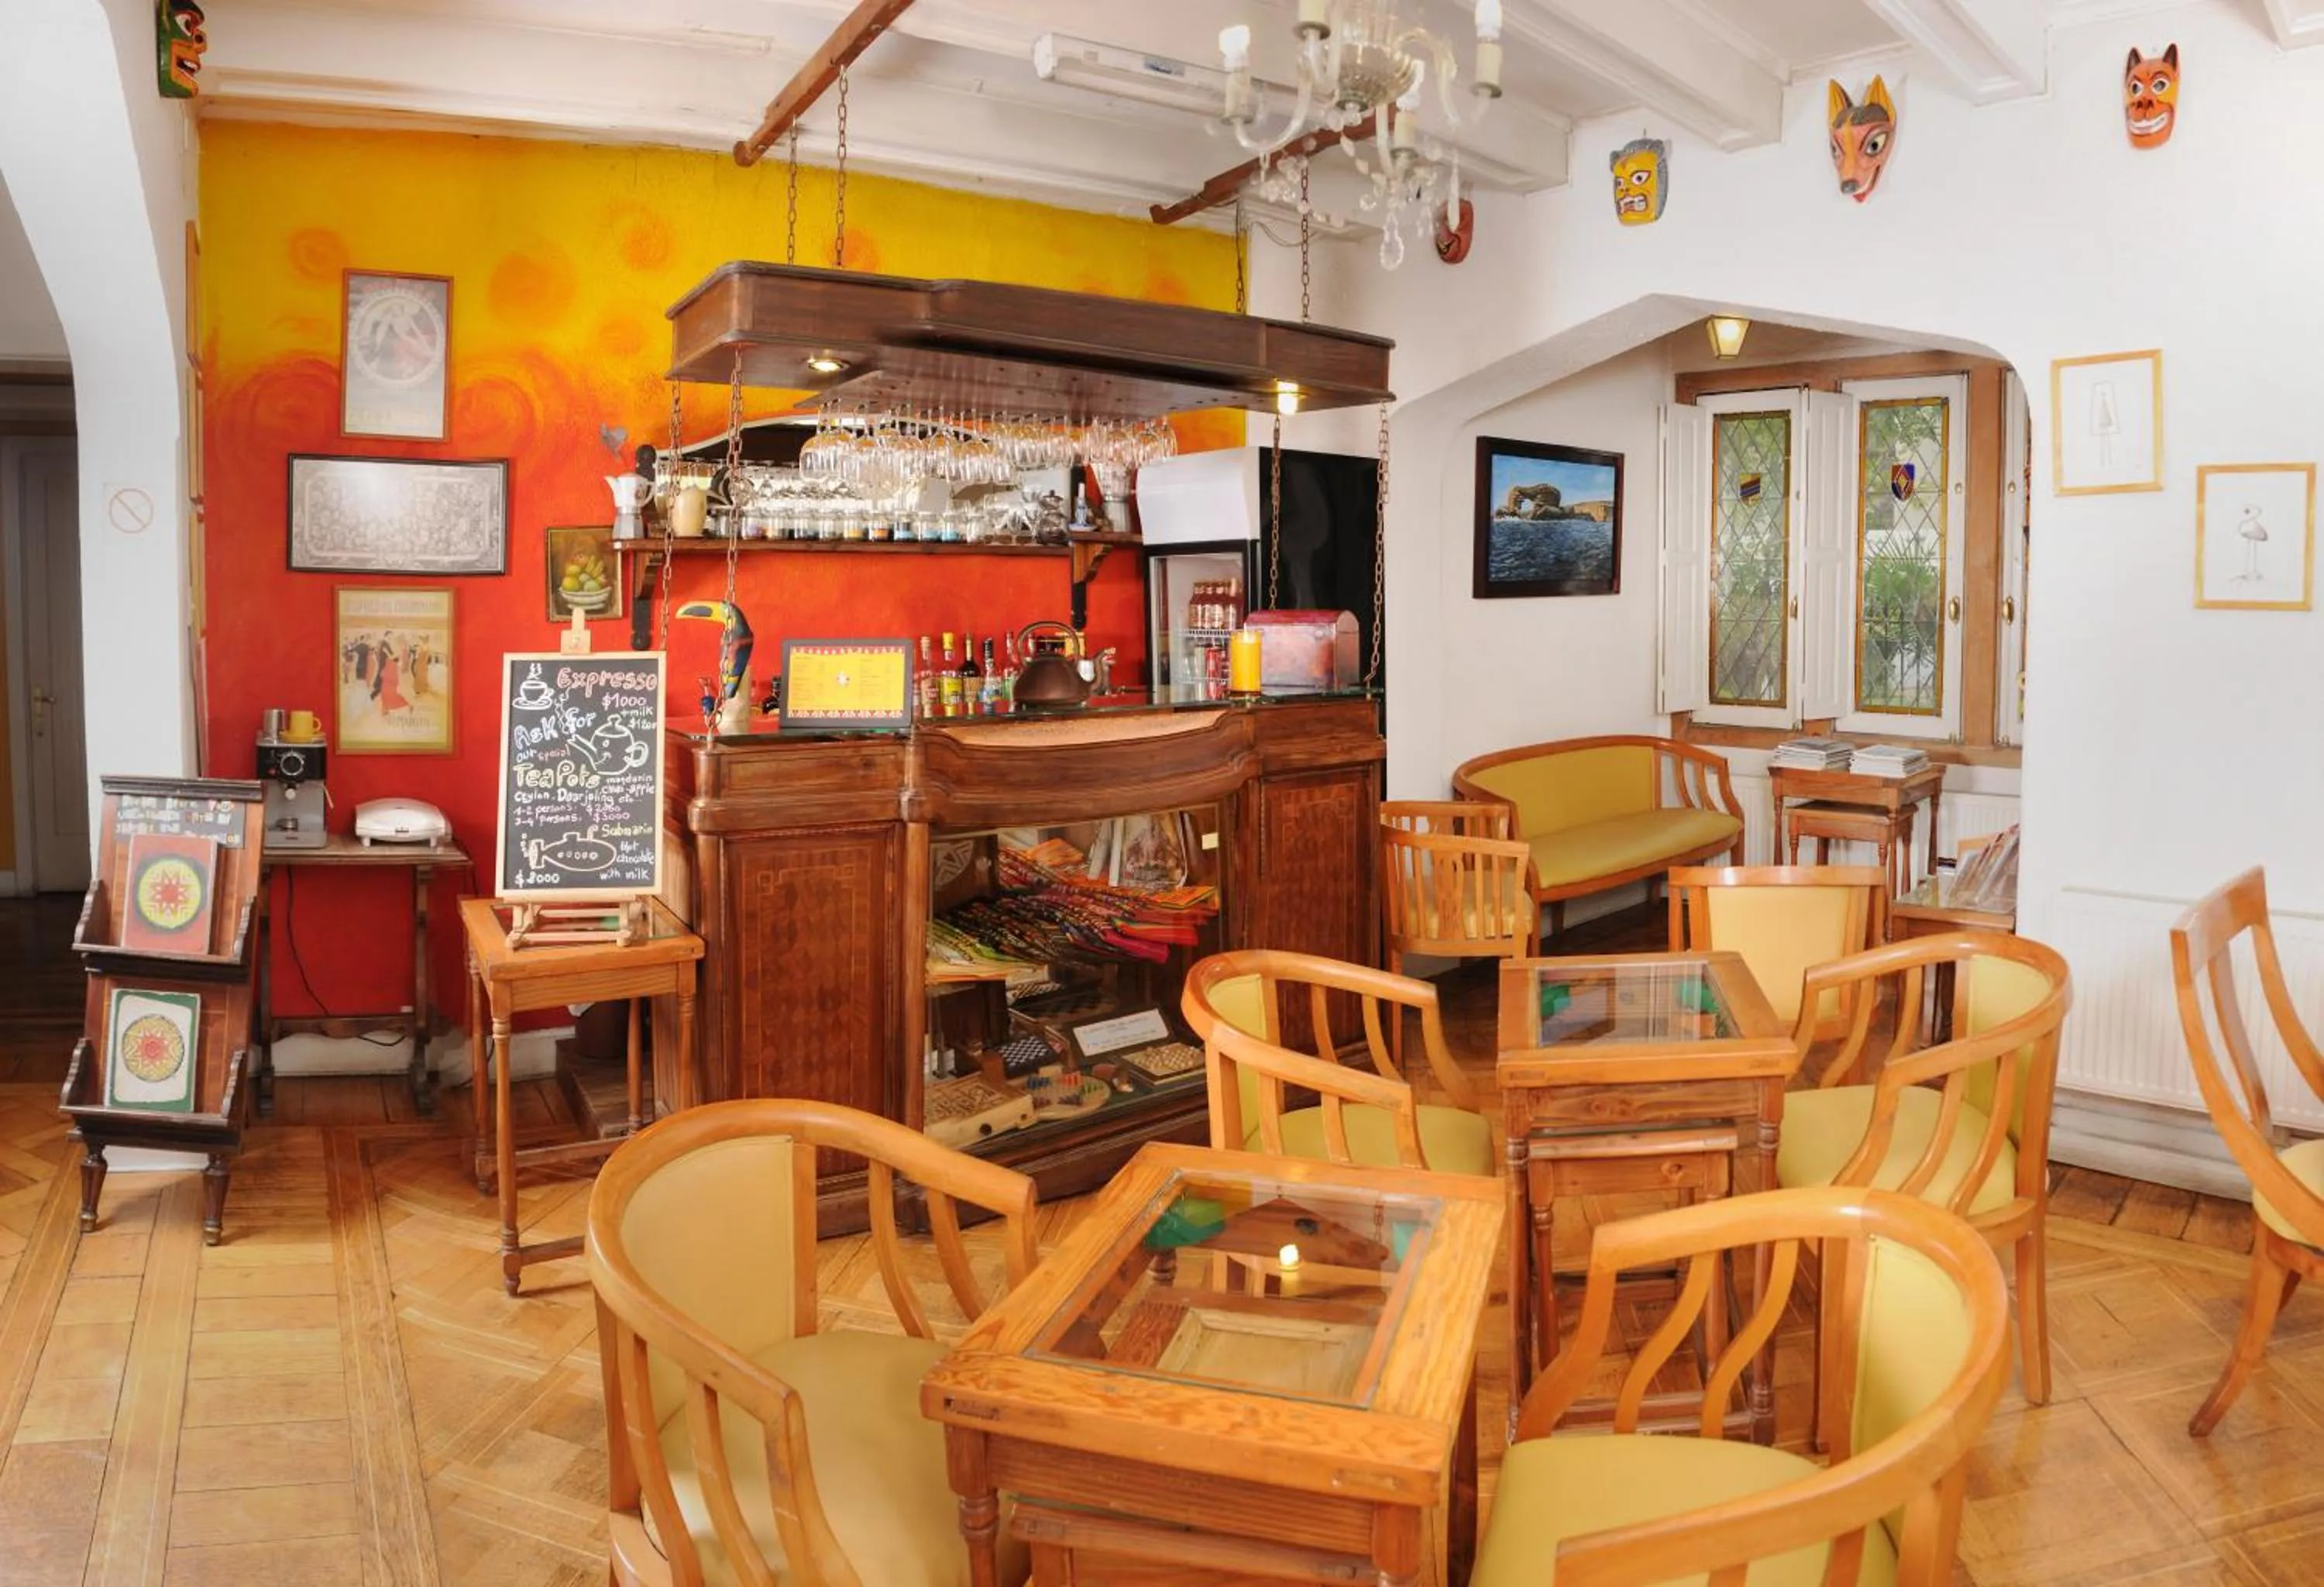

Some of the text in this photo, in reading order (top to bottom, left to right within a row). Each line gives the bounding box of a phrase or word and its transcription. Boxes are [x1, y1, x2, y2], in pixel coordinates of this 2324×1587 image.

[557, 666, 658, 698] Expresso
[601, 692, 647, 711] $1000
[516, 748, 538, 763] our
